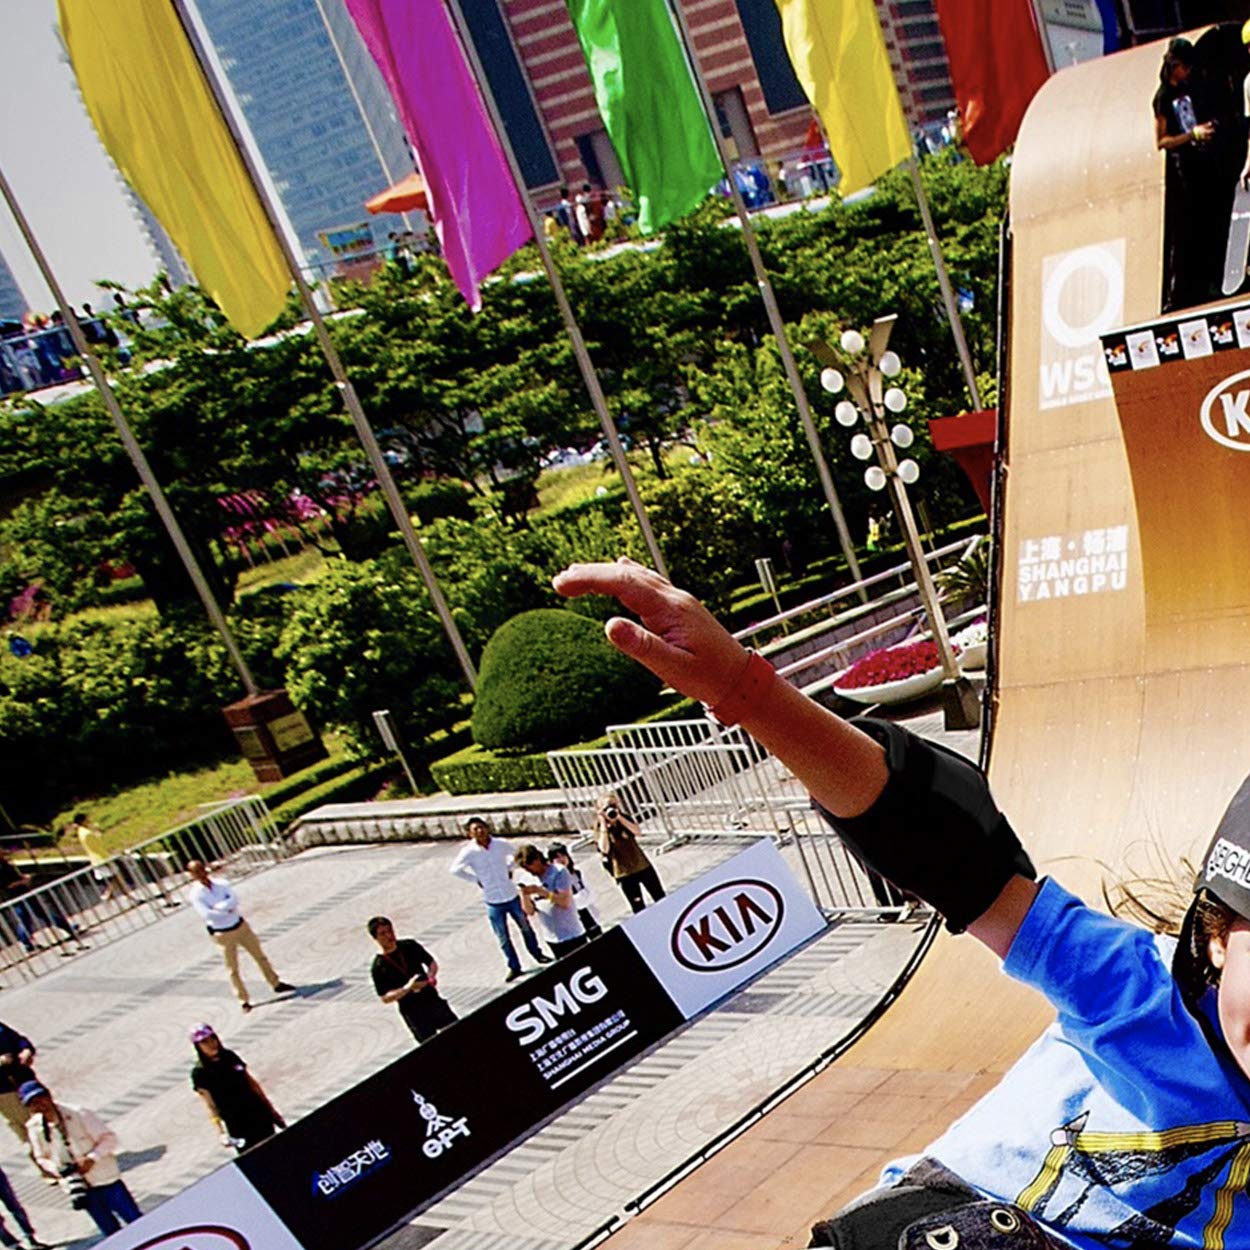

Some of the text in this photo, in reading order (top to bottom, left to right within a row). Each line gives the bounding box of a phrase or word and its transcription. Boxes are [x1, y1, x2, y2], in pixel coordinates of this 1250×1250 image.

[1019, 551, 1127, 583] SHANGHAI
[1019, 571, 1127, 602] YANGPU
[684, 892, 774, 962] KIA
[505, 966, 608, 1046] SMG
[422, 1116, 471, 1158] OPT
